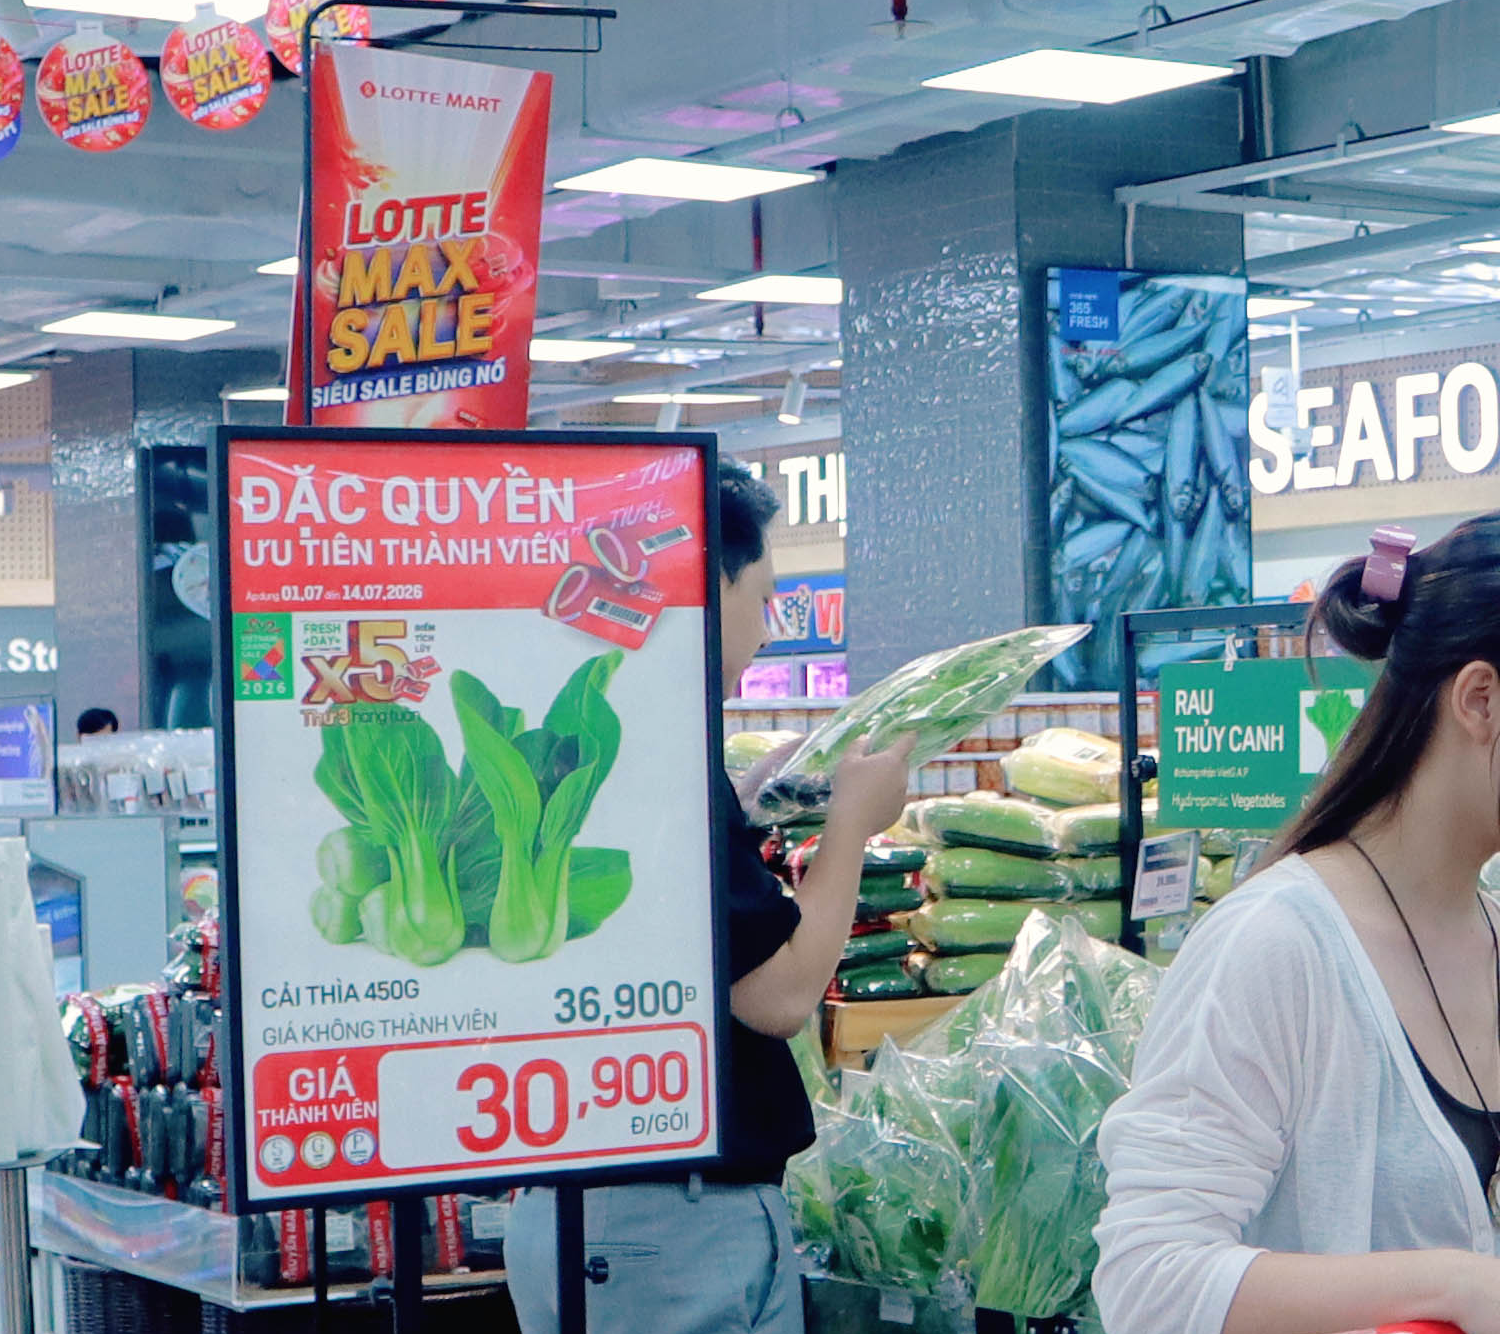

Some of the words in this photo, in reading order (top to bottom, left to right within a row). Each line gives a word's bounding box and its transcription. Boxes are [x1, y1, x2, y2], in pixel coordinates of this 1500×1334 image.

[380, 86, 440, 106] LOTTE
[446, 93, 500, 113] MART
[345, 190, 491, 249] LOTTE
[339, 237, 480, 307] MAX
[1069, 301, 1091, 314] 365
[1069, 315, 1108, 329] FRESH
[328, 293, 494, 373] SALE
[312, 379, 356, 408] SIÊU
[360, 374, 413, 402] SALE
[417, 366, 471, 394] BÙNG
[238, 464, 366, 538] ĐẶC
[382, 462, 574, 526] QUYỀN
[243, 538, 292, 567] ƯU
[302, 532, 372, 566] TIÊN
[380, 531, 490, 565] THÀNH
[496, 532, 570, 564] VIÊN
[281, 586, 323, 601] 01.07
[342, 585, 423, 600] 14.07.2026
[304, 623, 341, 633] FRESH
[242, 683, 286, 694] 2026
[1175, 689, 1214, 716] RAU
[1174, 719, 1226, 753] THỦY
[1229, 725, 1284, 752] CANH
[1231, 793, 1285, 811] Vegetables
[262, 986, 300, 1008] CẢI
[306, 982, 360, 1006] THÌA
[364, 979, 419, 1000] 450G
[554, 981, 684, 1027] 36,900
[262, 1023, 298, 1046] GIÁ
[302, 1017, 374, 1043] KHÔNG
[381, 1014, 449, 1037] THÀNH
[452, 1011, 498, 1034] VIÊN
[288, 1055, 356, 1102] GIÁ
[258, 1099, 329, 1127] THÀNH
[332, 1097, 376, 1121] VIÊN
[456, 1051, 689, 1153] 30,900
[631, 1112, 689, 1136] Đ/GÓI
